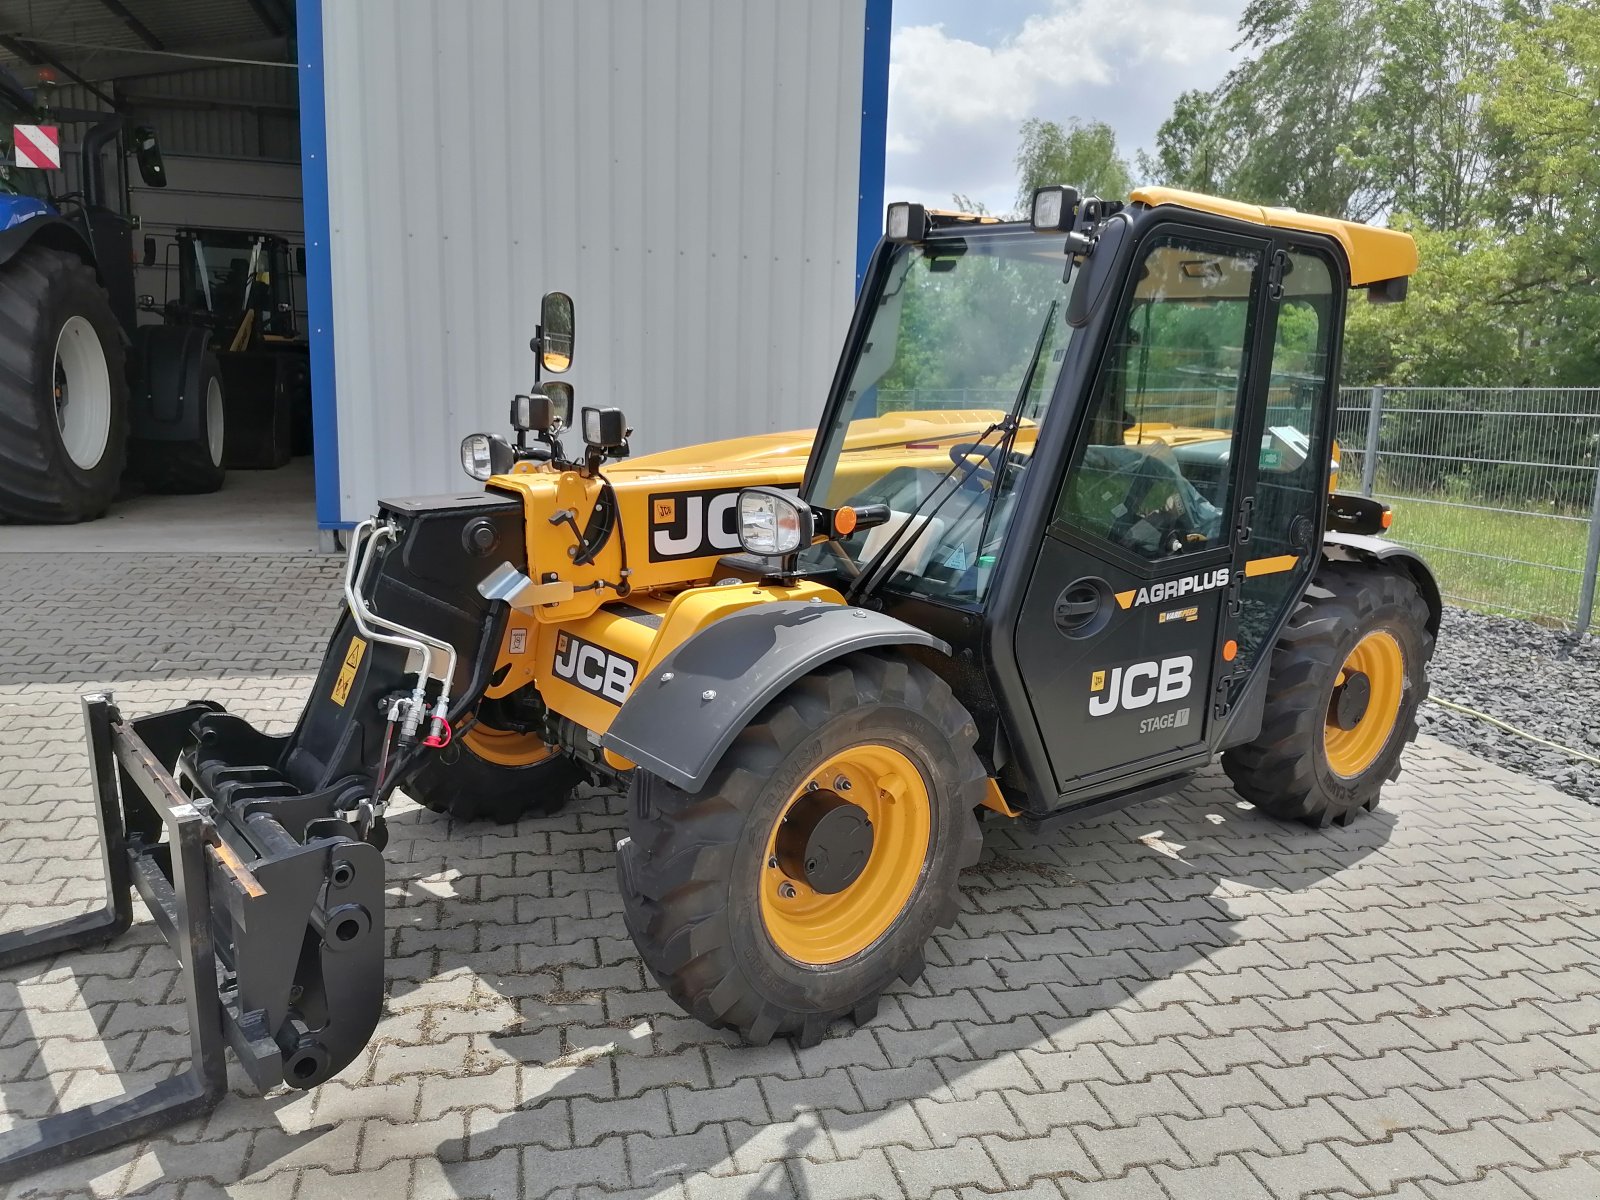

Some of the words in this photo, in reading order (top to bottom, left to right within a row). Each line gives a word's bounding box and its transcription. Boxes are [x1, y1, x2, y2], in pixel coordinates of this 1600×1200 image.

[654, 488, 799, 555] JC
[1134, 568, 1229, 607] AGRIPLUS
[555, 639, 635, 704] JCB
[1089, 655, 1193, 717] JCB
[1139, 713, 1175, 734] STAGE
